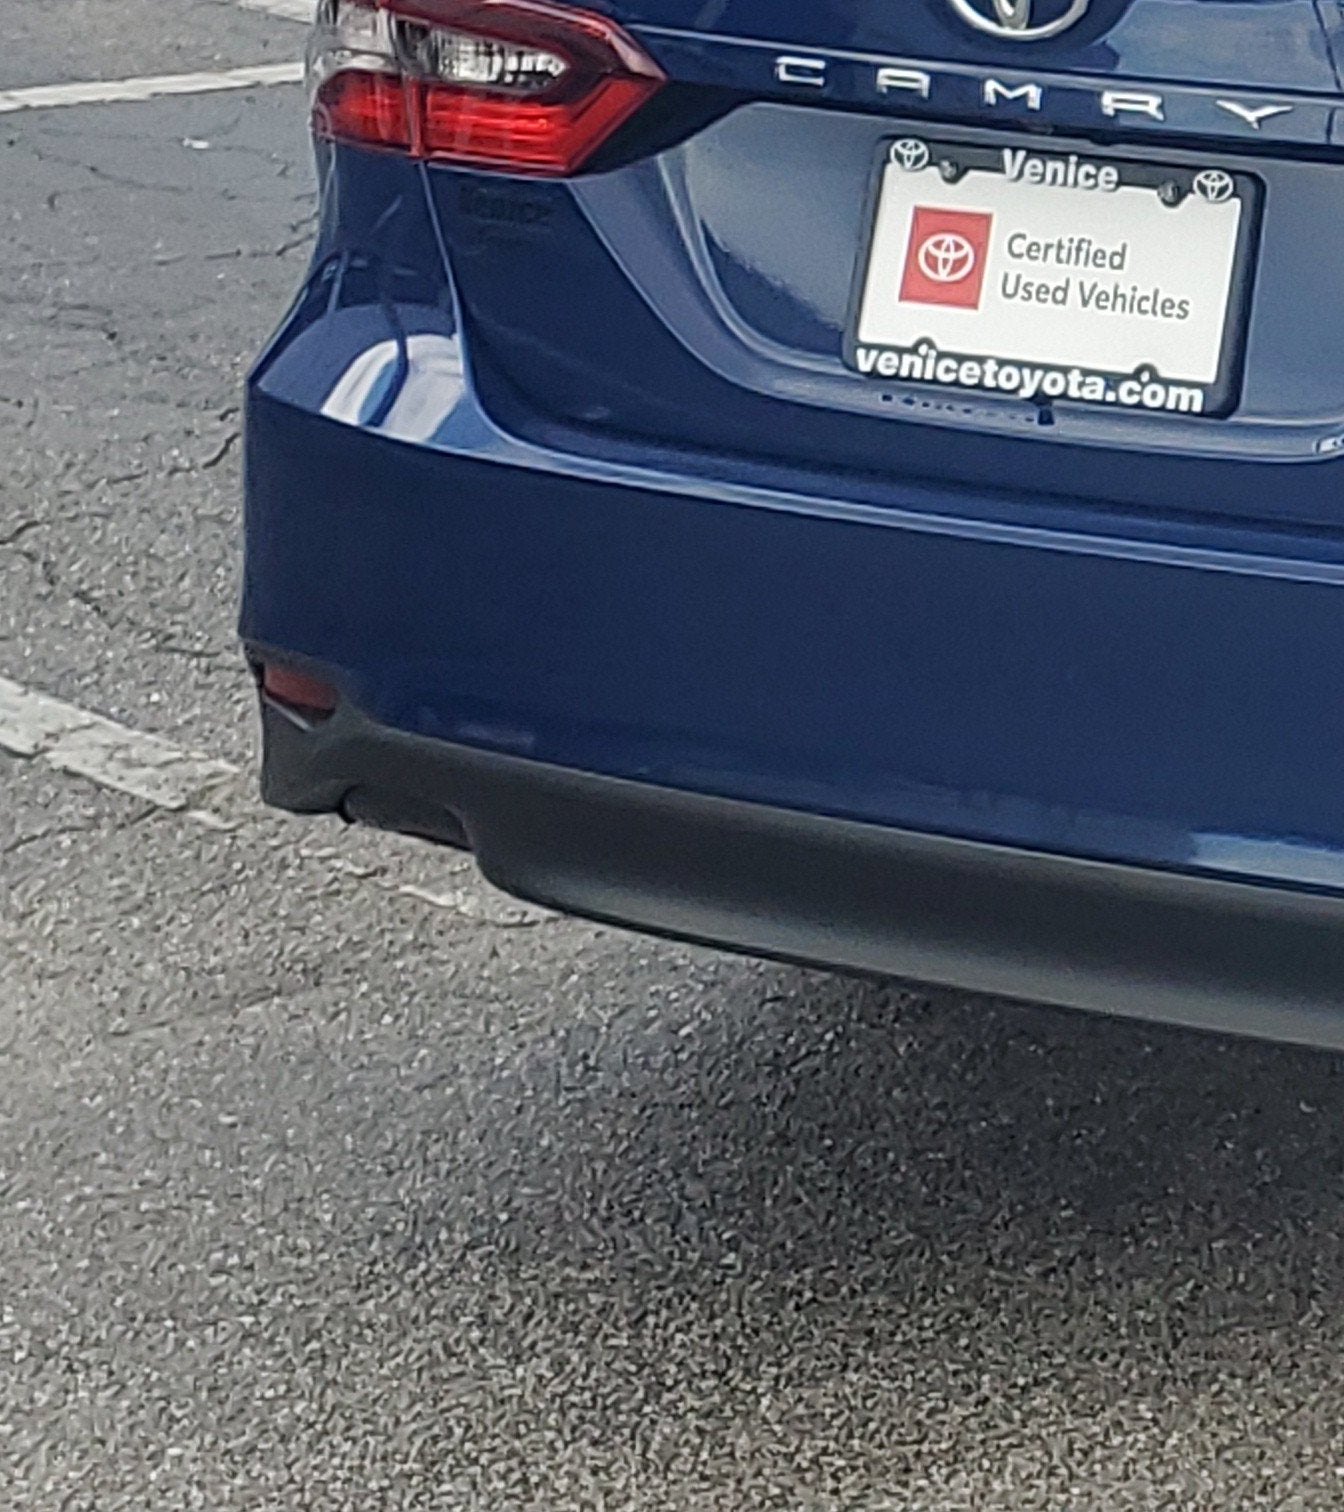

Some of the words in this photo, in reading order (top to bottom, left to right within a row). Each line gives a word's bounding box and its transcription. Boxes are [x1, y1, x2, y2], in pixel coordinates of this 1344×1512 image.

[775, 55, 1293, 130] CAMRY
[1002, 147, 1120, 192] Venice
[1006, 232, 1128, 271] Certified
[1001, 272, 1072, 307] Used
[1077, 278, 1191, 320] Vehicles
[856, 346, 1205, 414] venicetoyota.com
